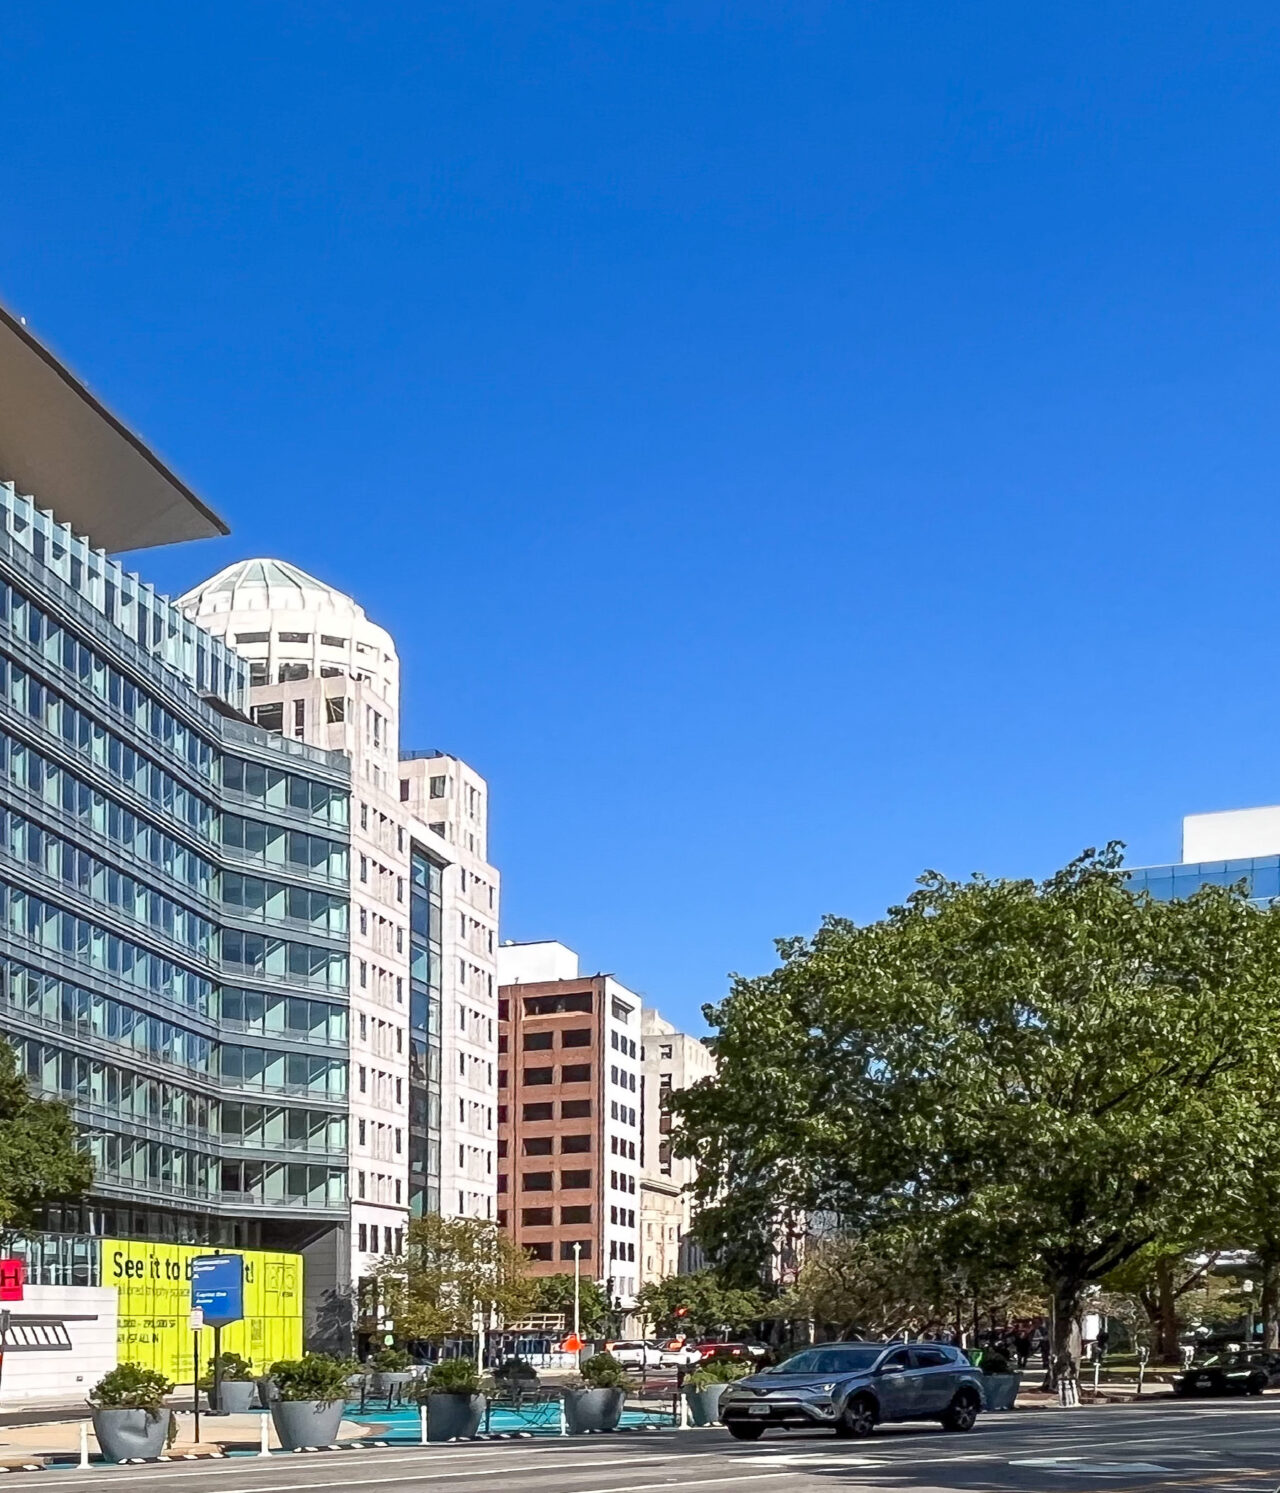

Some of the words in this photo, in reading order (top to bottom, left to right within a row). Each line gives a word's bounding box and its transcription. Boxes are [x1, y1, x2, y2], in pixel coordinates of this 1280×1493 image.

[113, 1251, 143, 1278] See
[150, 1253, 160, 1279] it
[165, 1258, 180, 1281] to
